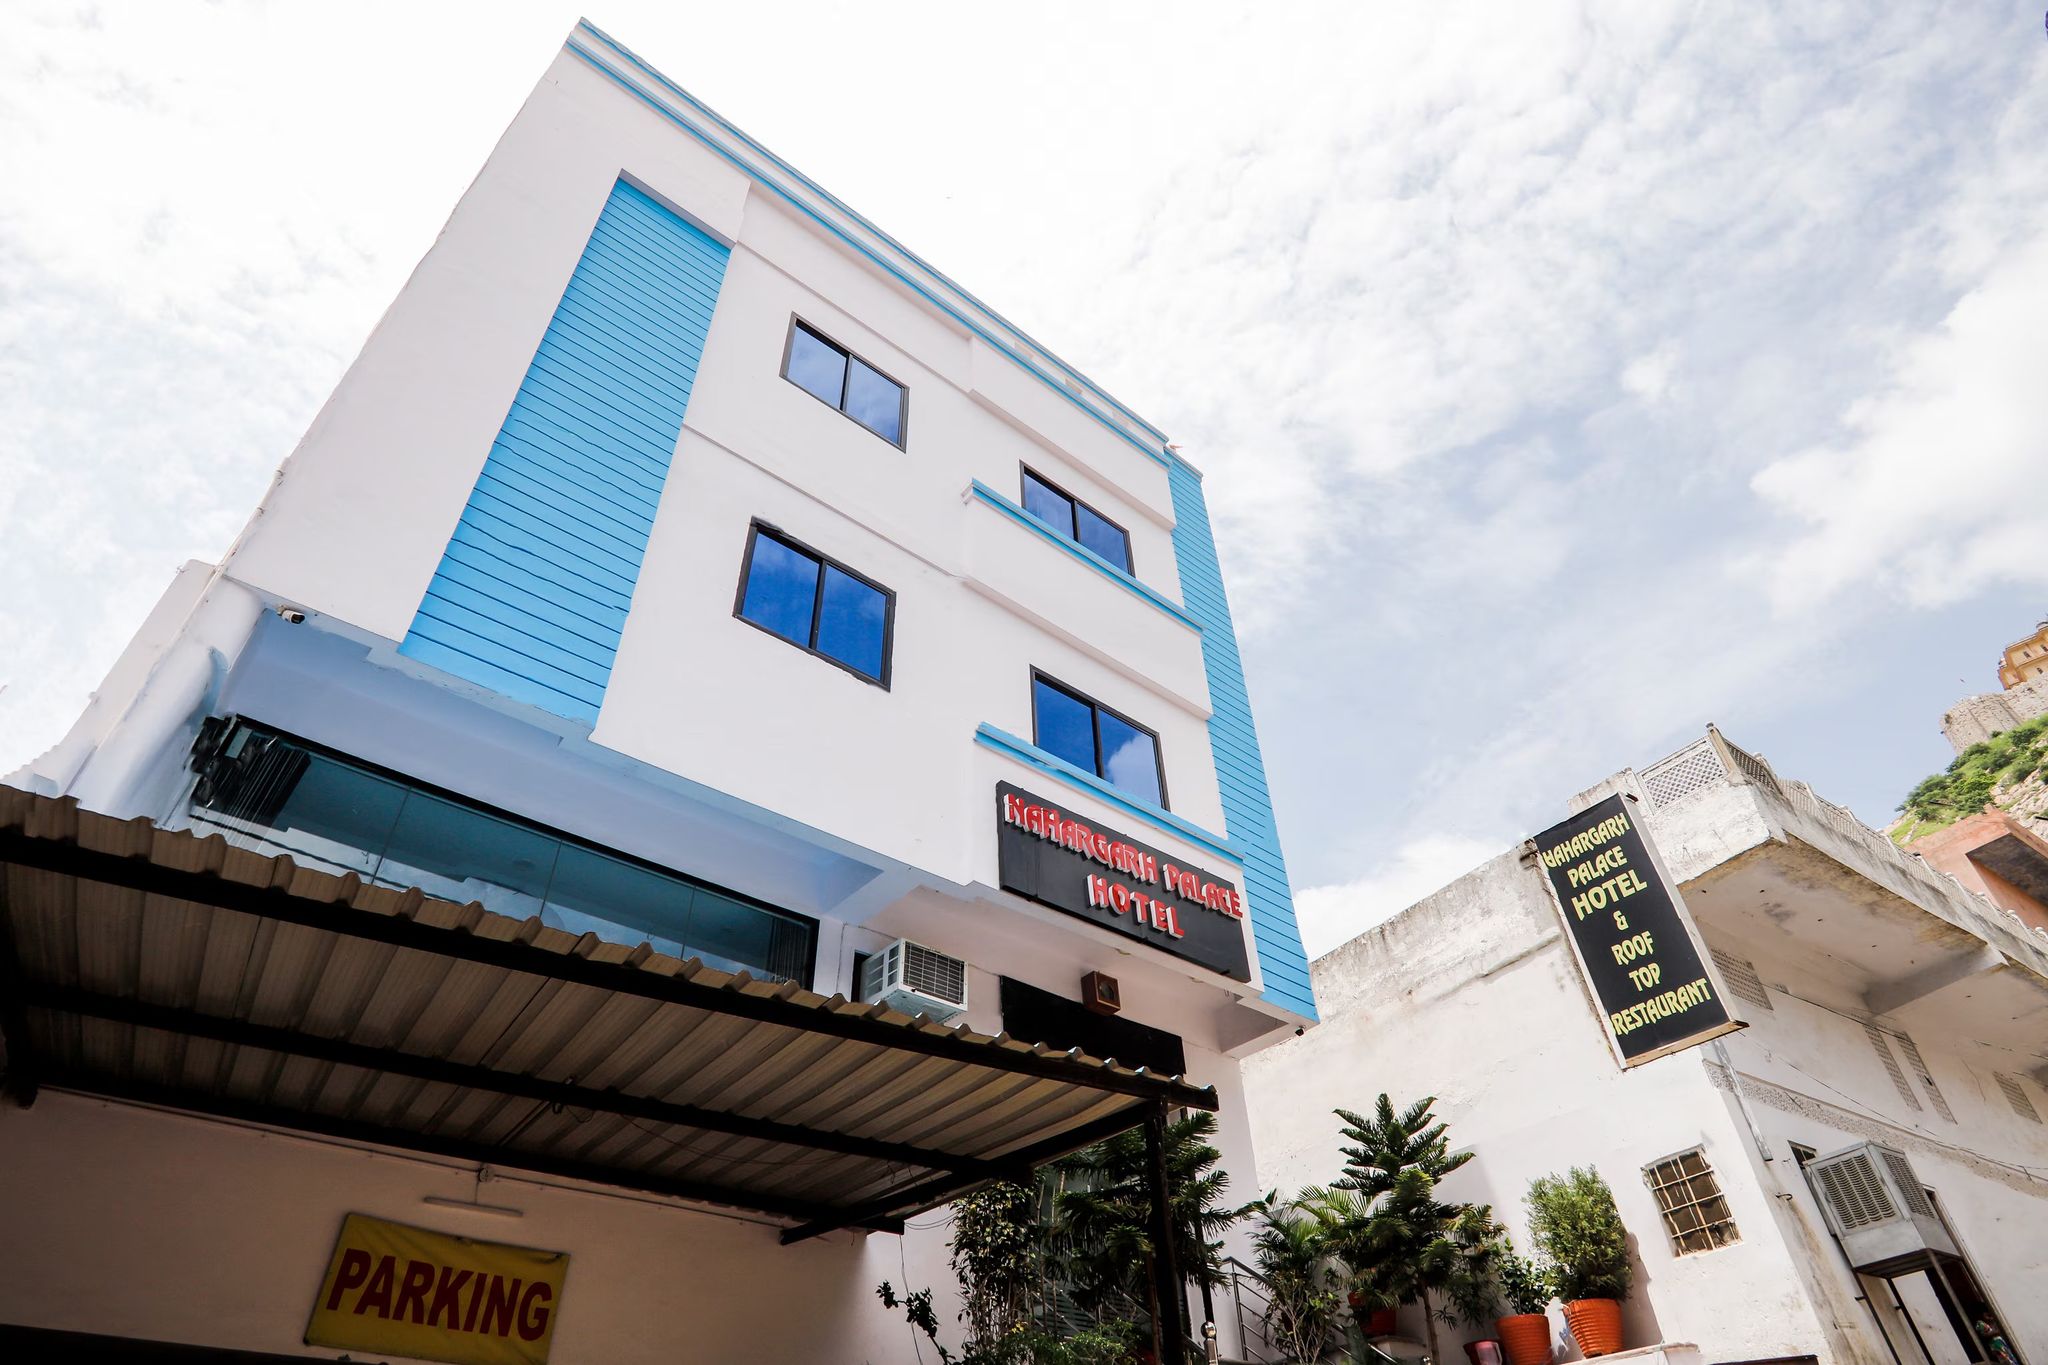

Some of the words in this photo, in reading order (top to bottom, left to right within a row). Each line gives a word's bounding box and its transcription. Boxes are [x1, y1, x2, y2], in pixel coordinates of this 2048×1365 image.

[1004, 793, 1158, 884] NAHARGARH
[1163, 863, 1243, 920] PALACE
[1567, 845, 1628, 889] PALACE
[1087, 874, 1185, 939] HOTEL
[1571, 869, 1648, 921] HOTEL
[1613, 910, 1628, 931] &
[1611, 930, 1654, 966] ROOF
[1629, 963, 1661, 992] TOP
[1609, 977, 1712, 1036] RESTAURANT
[326, 1247, 553, 1342] PARKING
